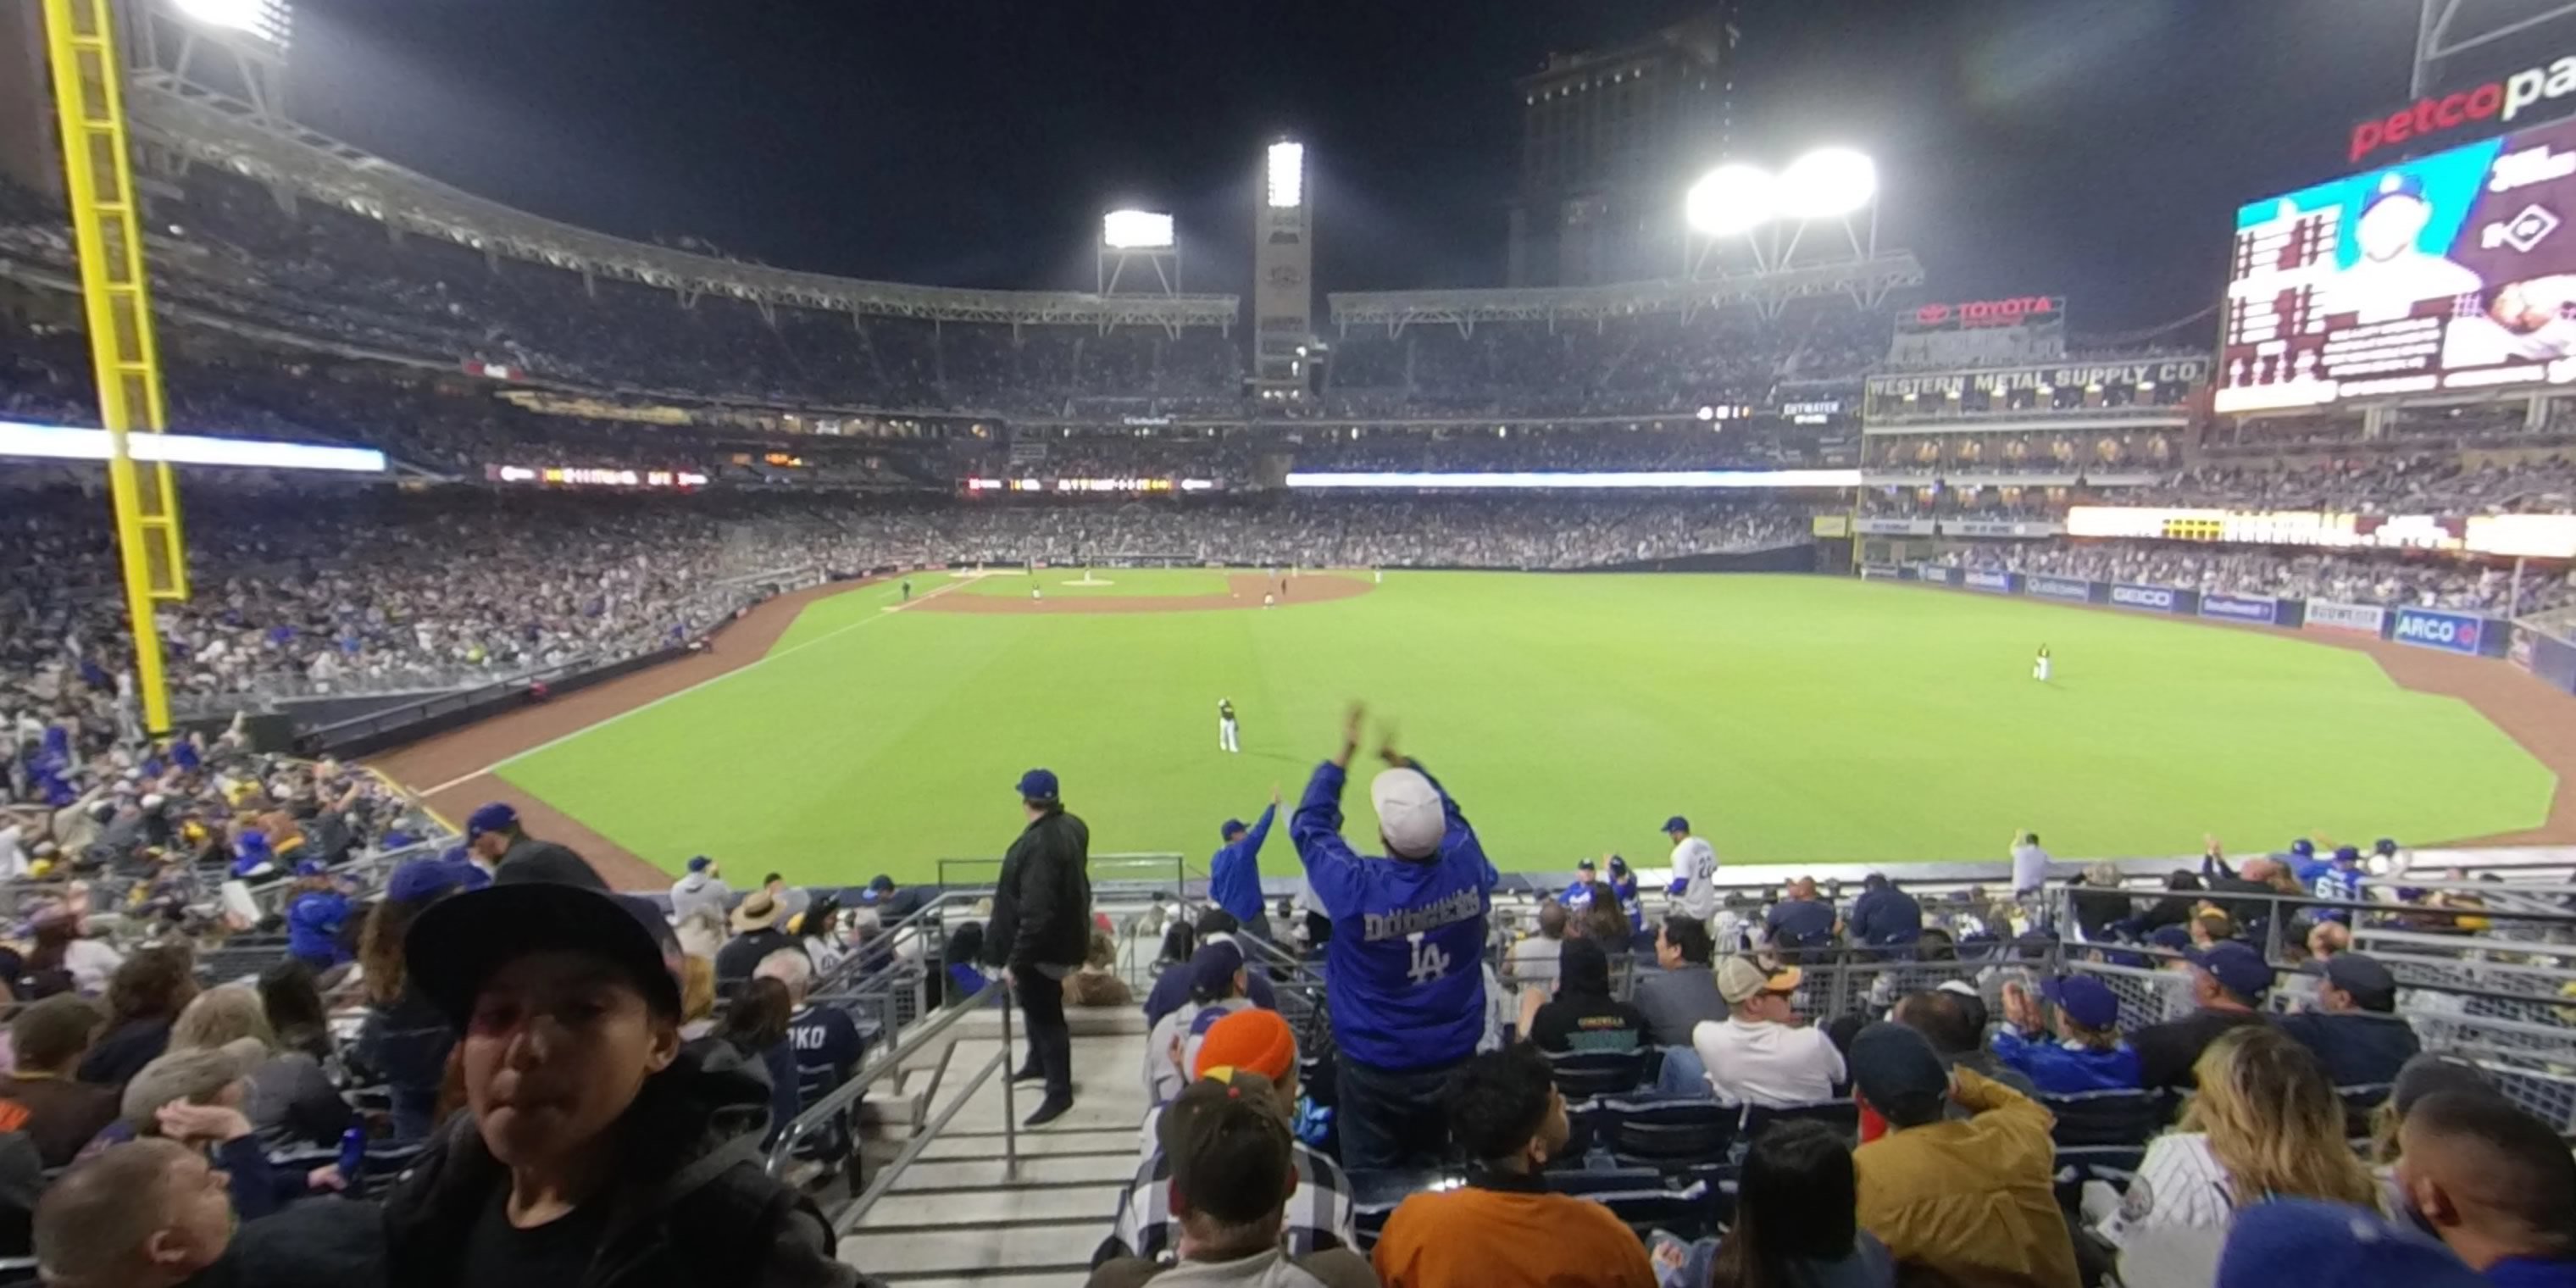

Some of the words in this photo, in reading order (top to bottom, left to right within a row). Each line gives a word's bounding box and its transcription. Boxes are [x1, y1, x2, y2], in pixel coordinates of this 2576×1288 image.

[1961, 297, 2051, 317] TOYOTA
[1868, 375, 1965, 397] WESTERN
[1974, 370, 2043, 391] METAL
[2054, 364, 2150, 388] SUPPLY
[2113, 586, 2170, 607] GEICO
[2397, 614, 2455, 642] ARCO
[1406, 931, 1451, 986] LA
